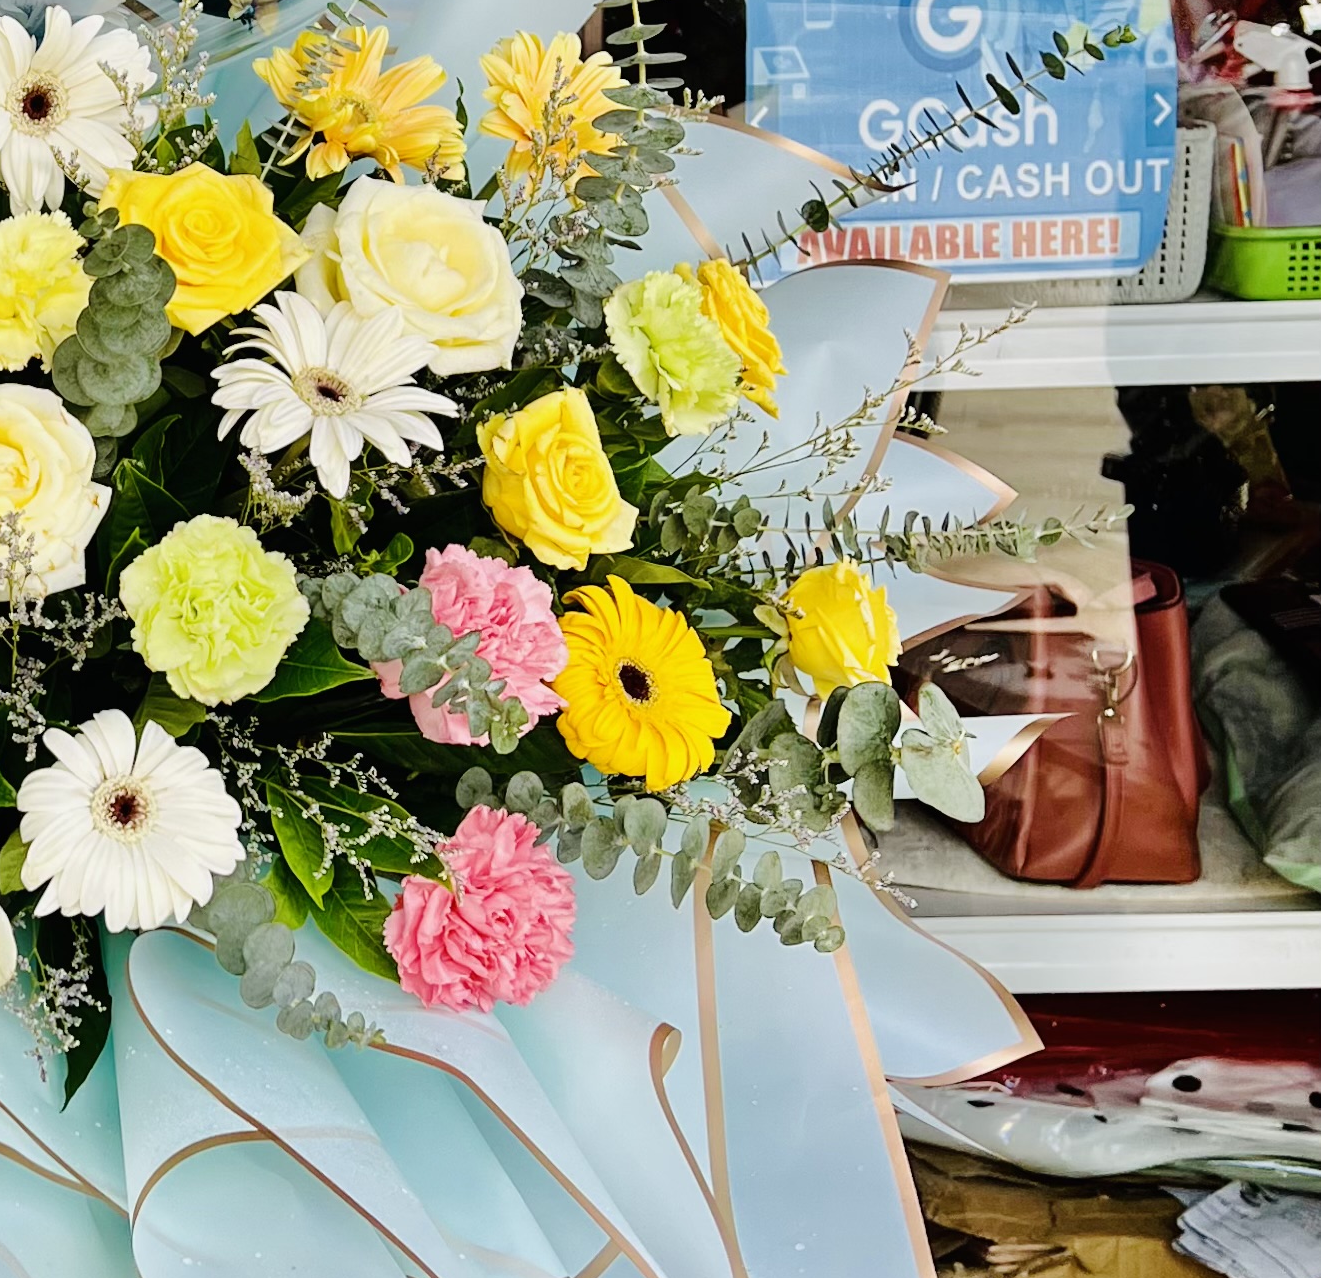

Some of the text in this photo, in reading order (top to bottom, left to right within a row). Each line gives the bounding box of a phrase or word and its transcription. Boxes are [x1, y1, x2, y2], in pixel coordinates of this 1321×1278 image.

[858, 96, 1058, 153] GCash
[955, 161, 1071, 202] CASH
[1084, 157, 1171, 196] OUT
[796, 217, 1121, 265] AVAILABLE HERE!
